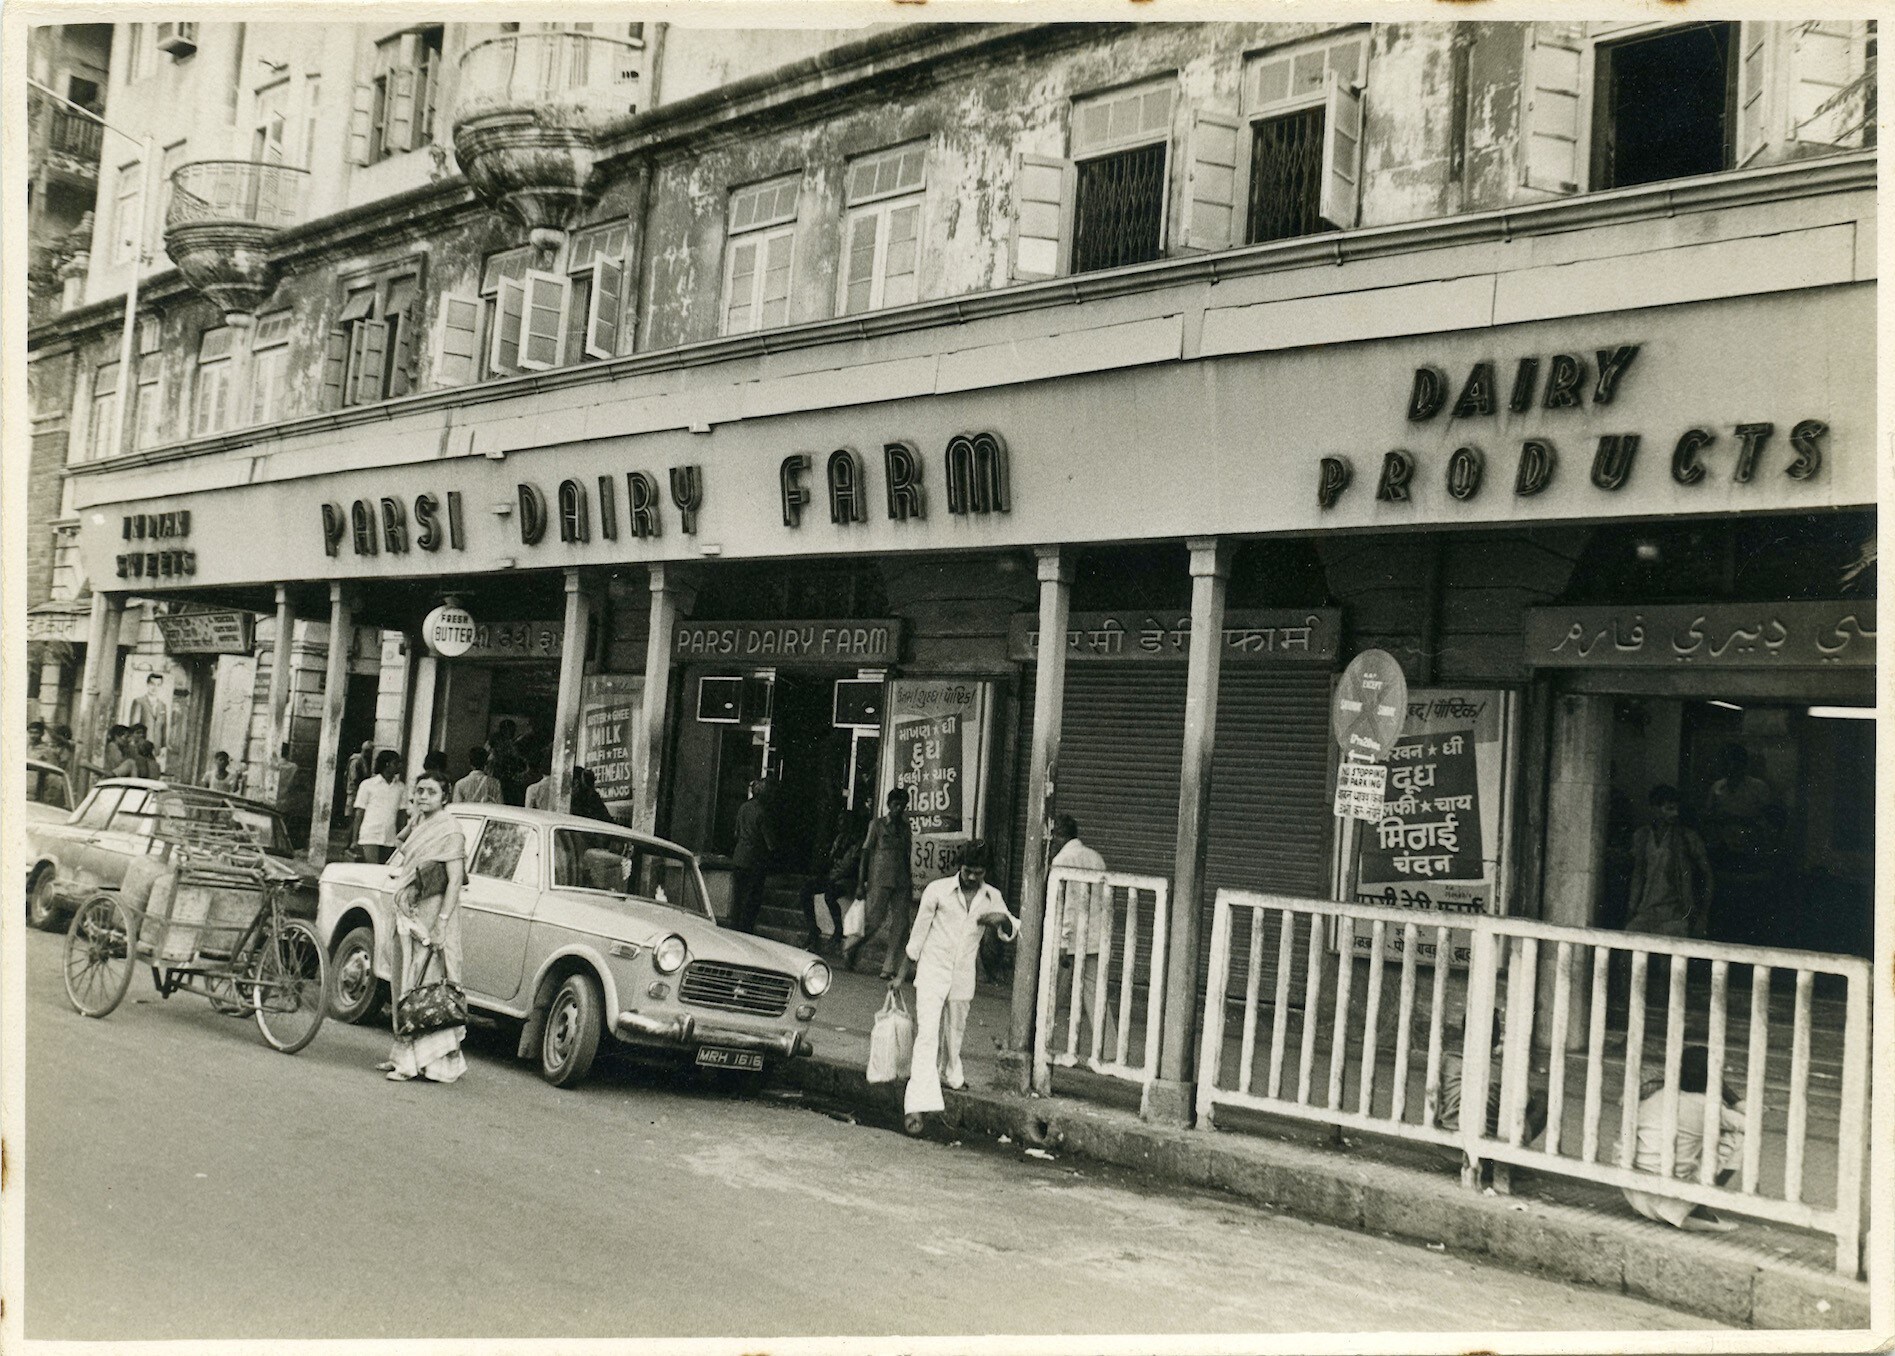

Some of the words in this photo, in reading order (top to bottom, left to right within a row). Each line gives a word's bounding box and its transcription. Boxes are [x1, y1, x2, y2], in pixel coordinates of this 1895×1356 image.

[1407, 345, 1641, 421] DAIRY
[1317, 419, 1829, 507] PRODUCTS
[321, 491, 464, 557] PARSI
[518, 465, 701, 546] DAIRY
[780, 430, 1011, 527] FARM
[122, 510, 191, 540] INDIAN
[116, 549, 196, 578] SWEETS
[440, 613, 469, 624] FRESH
[434, 626, 474, 644] BUTTER
[677, 629, 742, 653] PARSI
[747, 627, 814, 655] DAIRY
[820, 628, 888, 655] FARM
[611, 707, 631, 721] GHEE
[591, 724, 622, 748] MILK
[612, 747, 629, 760] TEA
[1350, 777, 1382, 789] PARKING
[1351, 767, 1386, 779] STOPPING
[1433, 794, 1474, 813] चाय
[1376, 813, 1460, 852] मिठाई
[1392, 850, 1455, 877] चंदन
[698, 1048, 728, 1064] MRH
[733, 1052, 762, 1067] 1616
